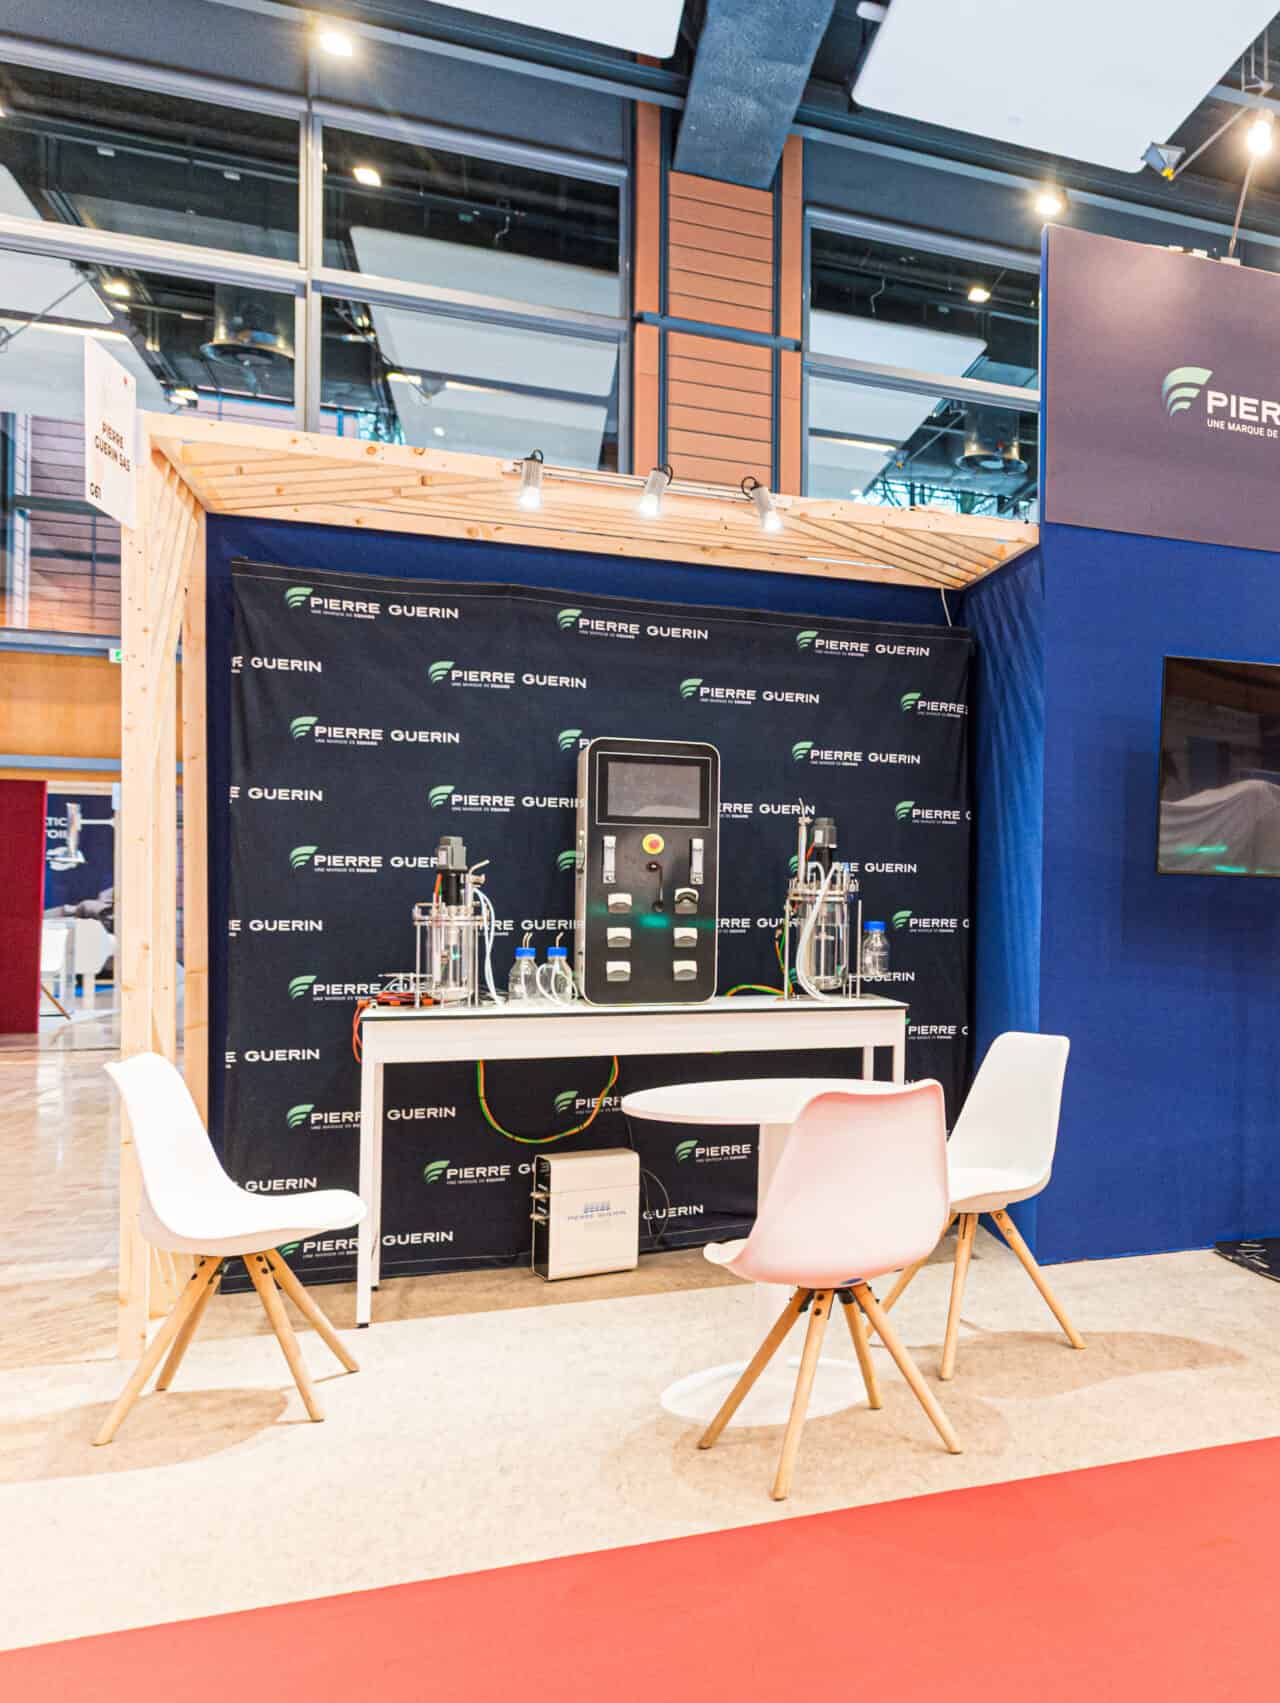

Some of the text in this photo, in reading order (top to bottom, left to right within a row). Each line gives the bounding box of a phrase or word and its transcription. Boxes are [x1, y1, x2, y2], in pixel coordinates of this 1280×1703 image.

[1207, 419, 1226, 430] UNE
[1227, 421, 1265, 436] MARQUE
[1267, 428, 1278, 438] DE
[310, 596, 380, 614] PIERRE
[388, 604, 459, 619] GUERIN
[578, 618, 640, 634] PIERRE
[647, 625, 708, 640] GUERIN
[815, 639, 869, 653] PIERRE
[875, 643, 930, 656] GUERIN
[251, 656, 322, 672] GUERIN
[450, 669, 515, 684] PIERRE
[522, 673, 587, 688] GUERIN
[700, 687, 756, 700] PIERRE
[762, 690, 819, 704] GUERIN
[917, 700, 965, 713] PIERRE
[314, 725, 383, 740] PIERRE
[390, 729, 460, 743] GUERIN
[810, 749, 862, 762] PIERRE
[868, 752, 921, 764] GUERIN
[248, 787, 323, 801] GUERIN
[450, 794, 578, 808] PIERRE GUERI
[911, 808, 961, 820] PIERRE
[313, 855, 438, 868] PIERRE GUER
[865, 862, 917, 873] GUERIN
[248, 919, 323, 932] GUERIN
[521, 919, 578, 931] GUERI
[909, 918, 958, 929] PIERRE
[312, 983, 382, 996] PIERRE
[908, 1025, 956, 1037] PIERRE
[244, 1048, 320, 1062] GUERIN
[387, 1106, 456, 1121] GUERIN
[695, 1143, 752, 1158] PIERRE
[446, 1165, 511, 1179] PIERRE
[245, 1177, 317, 1192] GUERIN
[642, 1204, 704, 1220] GUERIN
[381, 1231, 454, 1246] GUERIN
